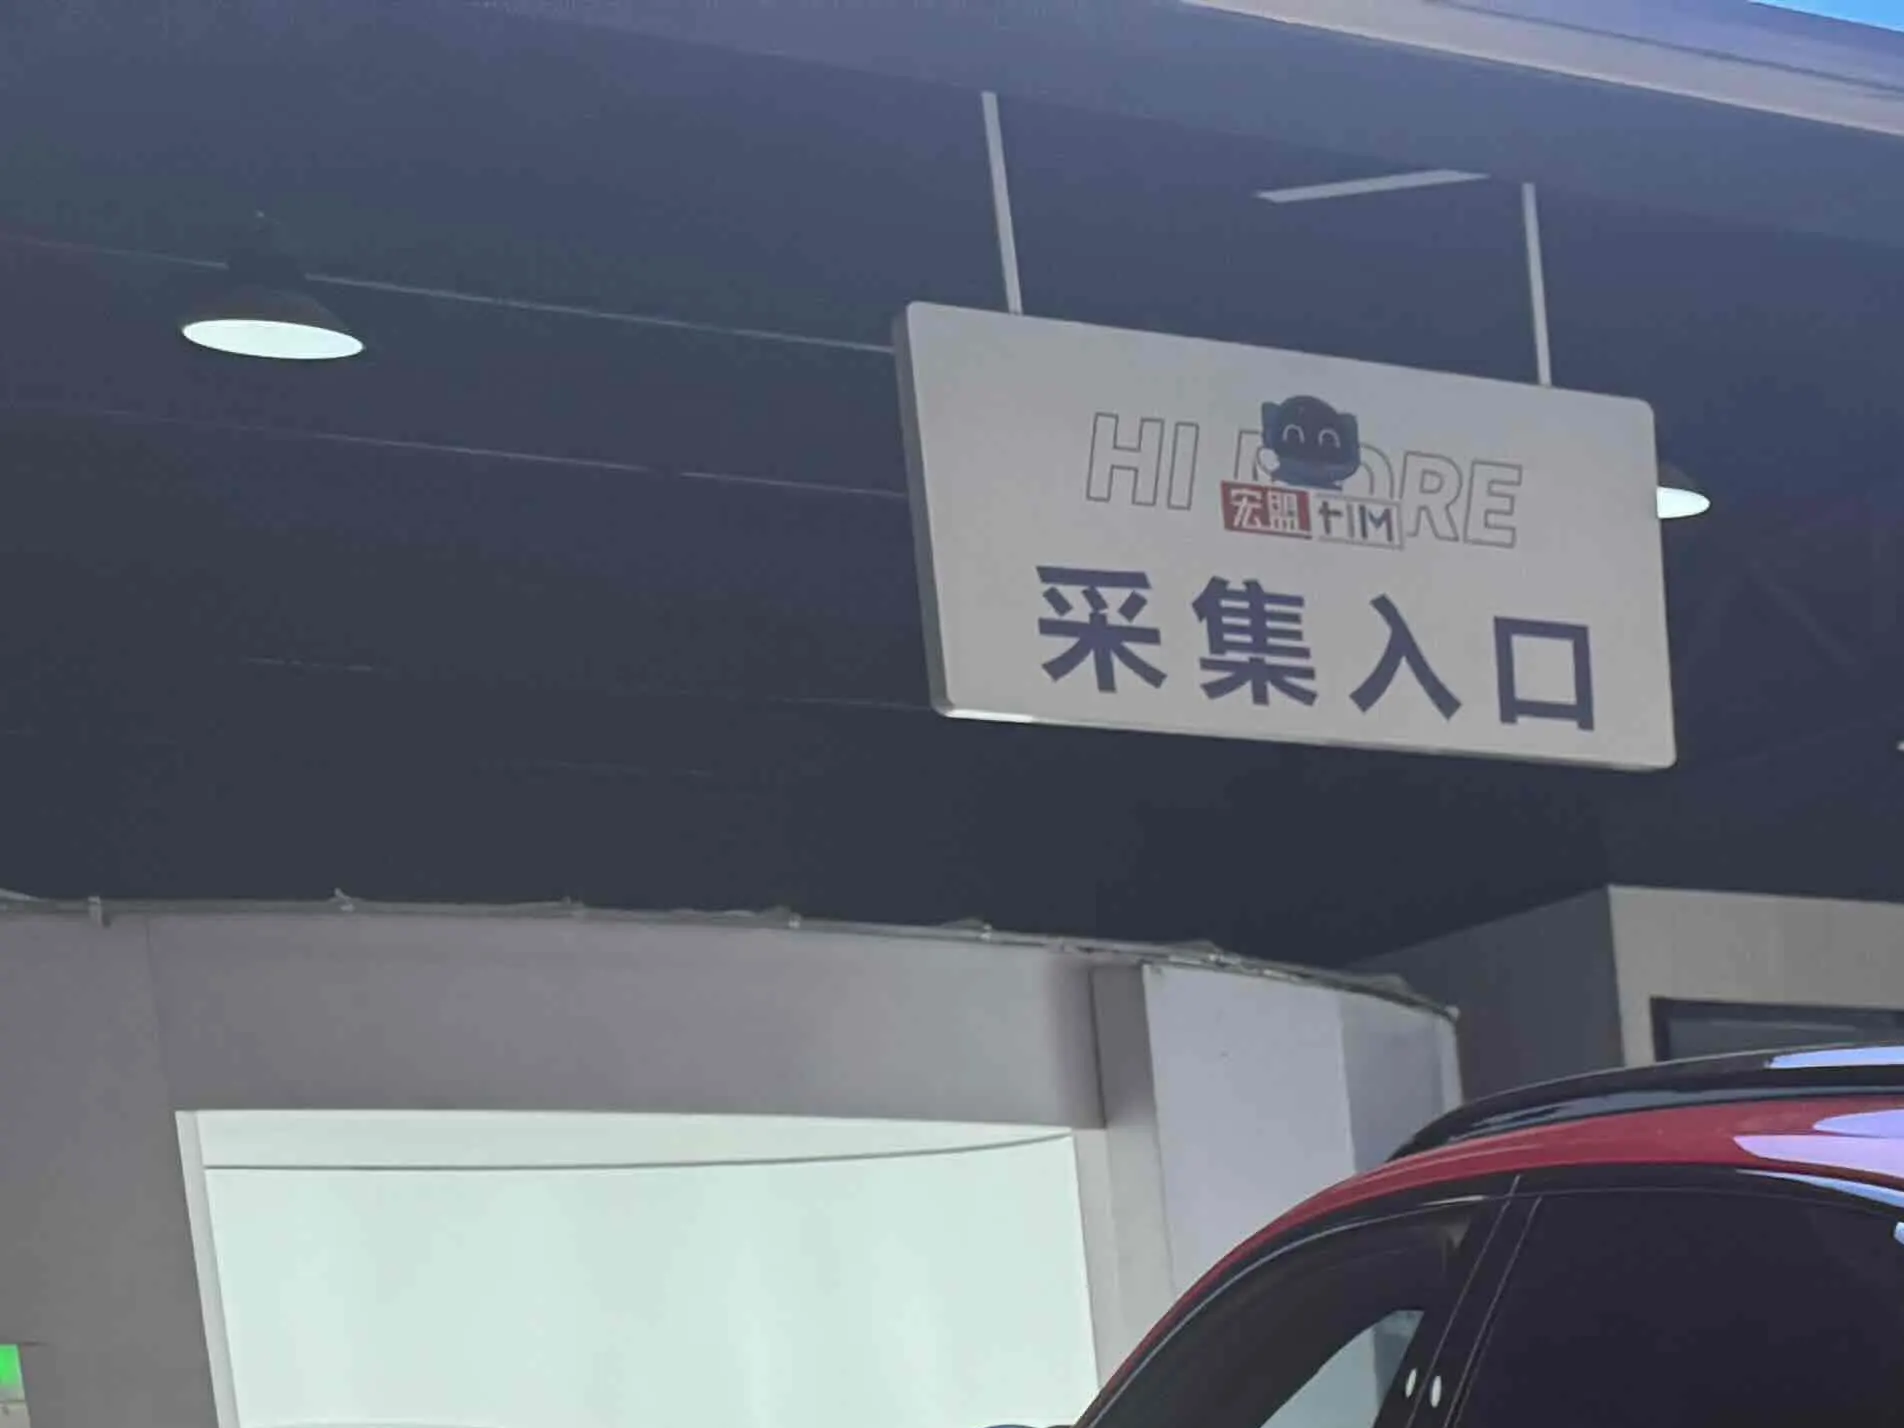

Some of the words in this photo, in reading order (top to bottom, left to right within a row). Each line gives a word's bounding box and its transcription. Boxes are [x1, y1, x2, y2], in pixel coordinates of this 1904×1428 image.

[1086, 412, 1199, 510] HI
[1234, 429, 1523, 549] RE
[1228, 486, 1302, 535] 宏盟
[1035, 564, 1597, 732] 采集入口
